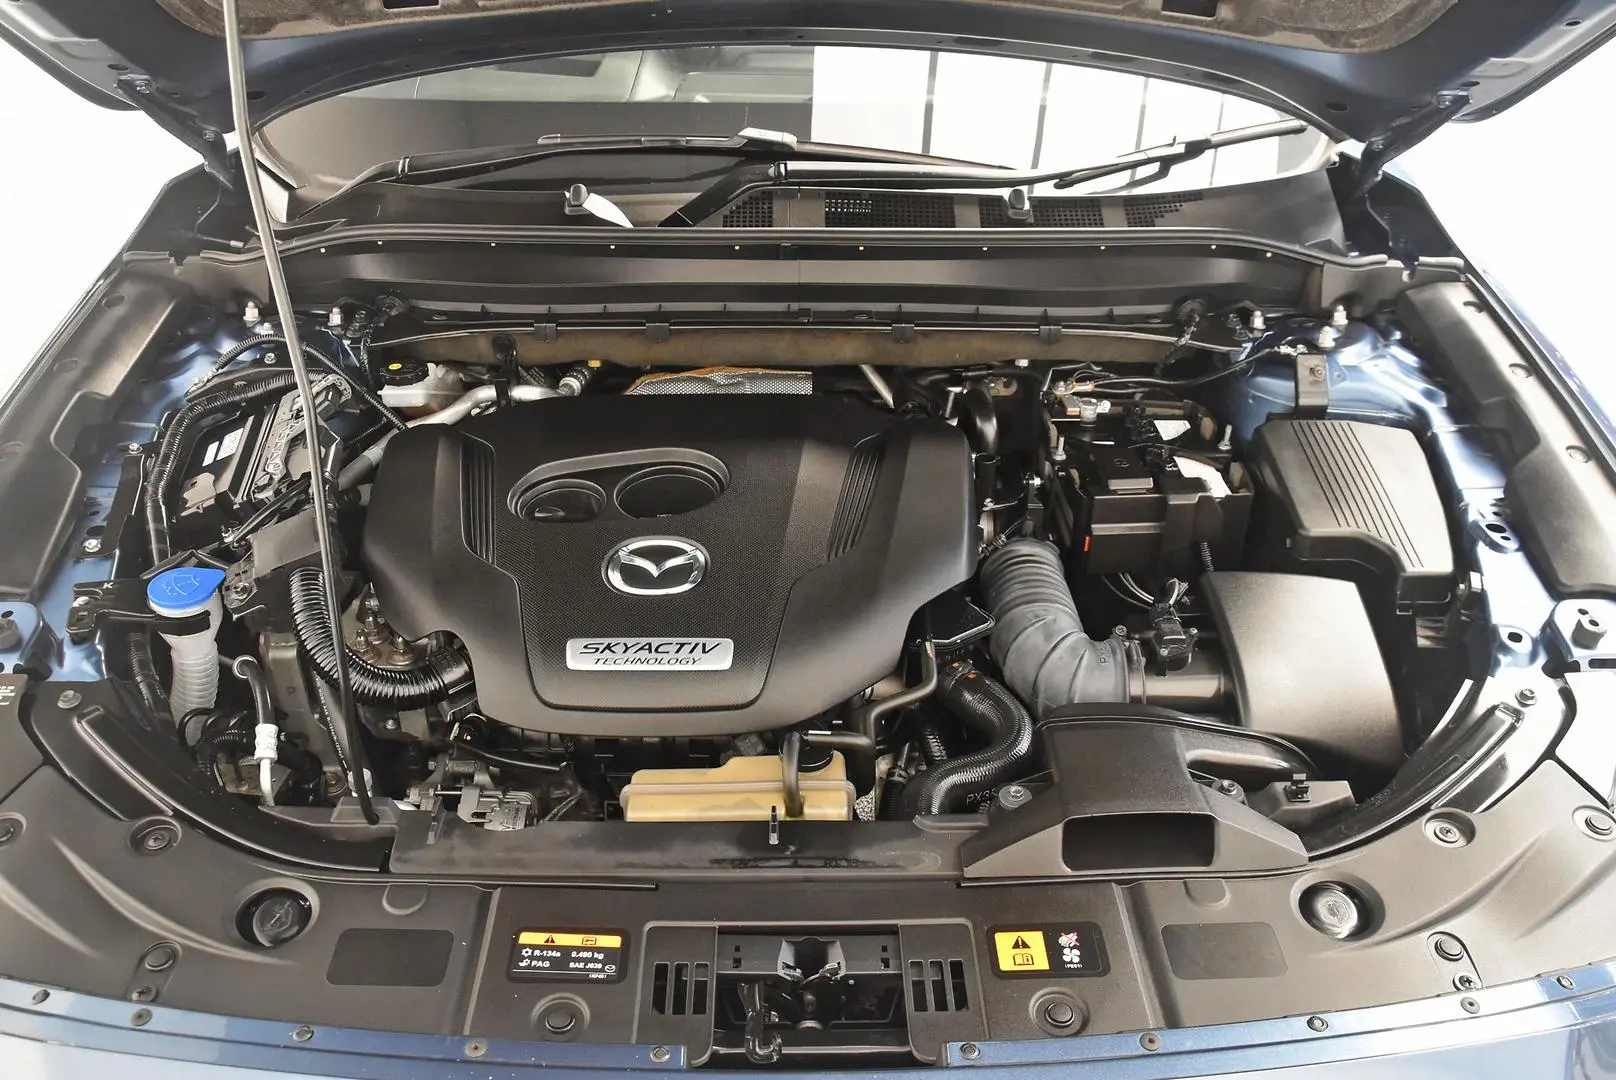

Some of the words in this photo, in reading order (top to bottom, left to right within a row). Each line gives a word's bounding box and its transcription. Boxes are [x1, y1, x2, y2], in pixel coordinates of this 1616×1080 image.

[578, 642, 722, 655] SKYACTIV
[593, 657, 703, 665] TECHNOLOGY
[533, 949, 561, 957] R-134a
[593, 951, 605, 960] kg
[531, 960, 551, 968] PAG
[569, 961, 585, 969] SAE
